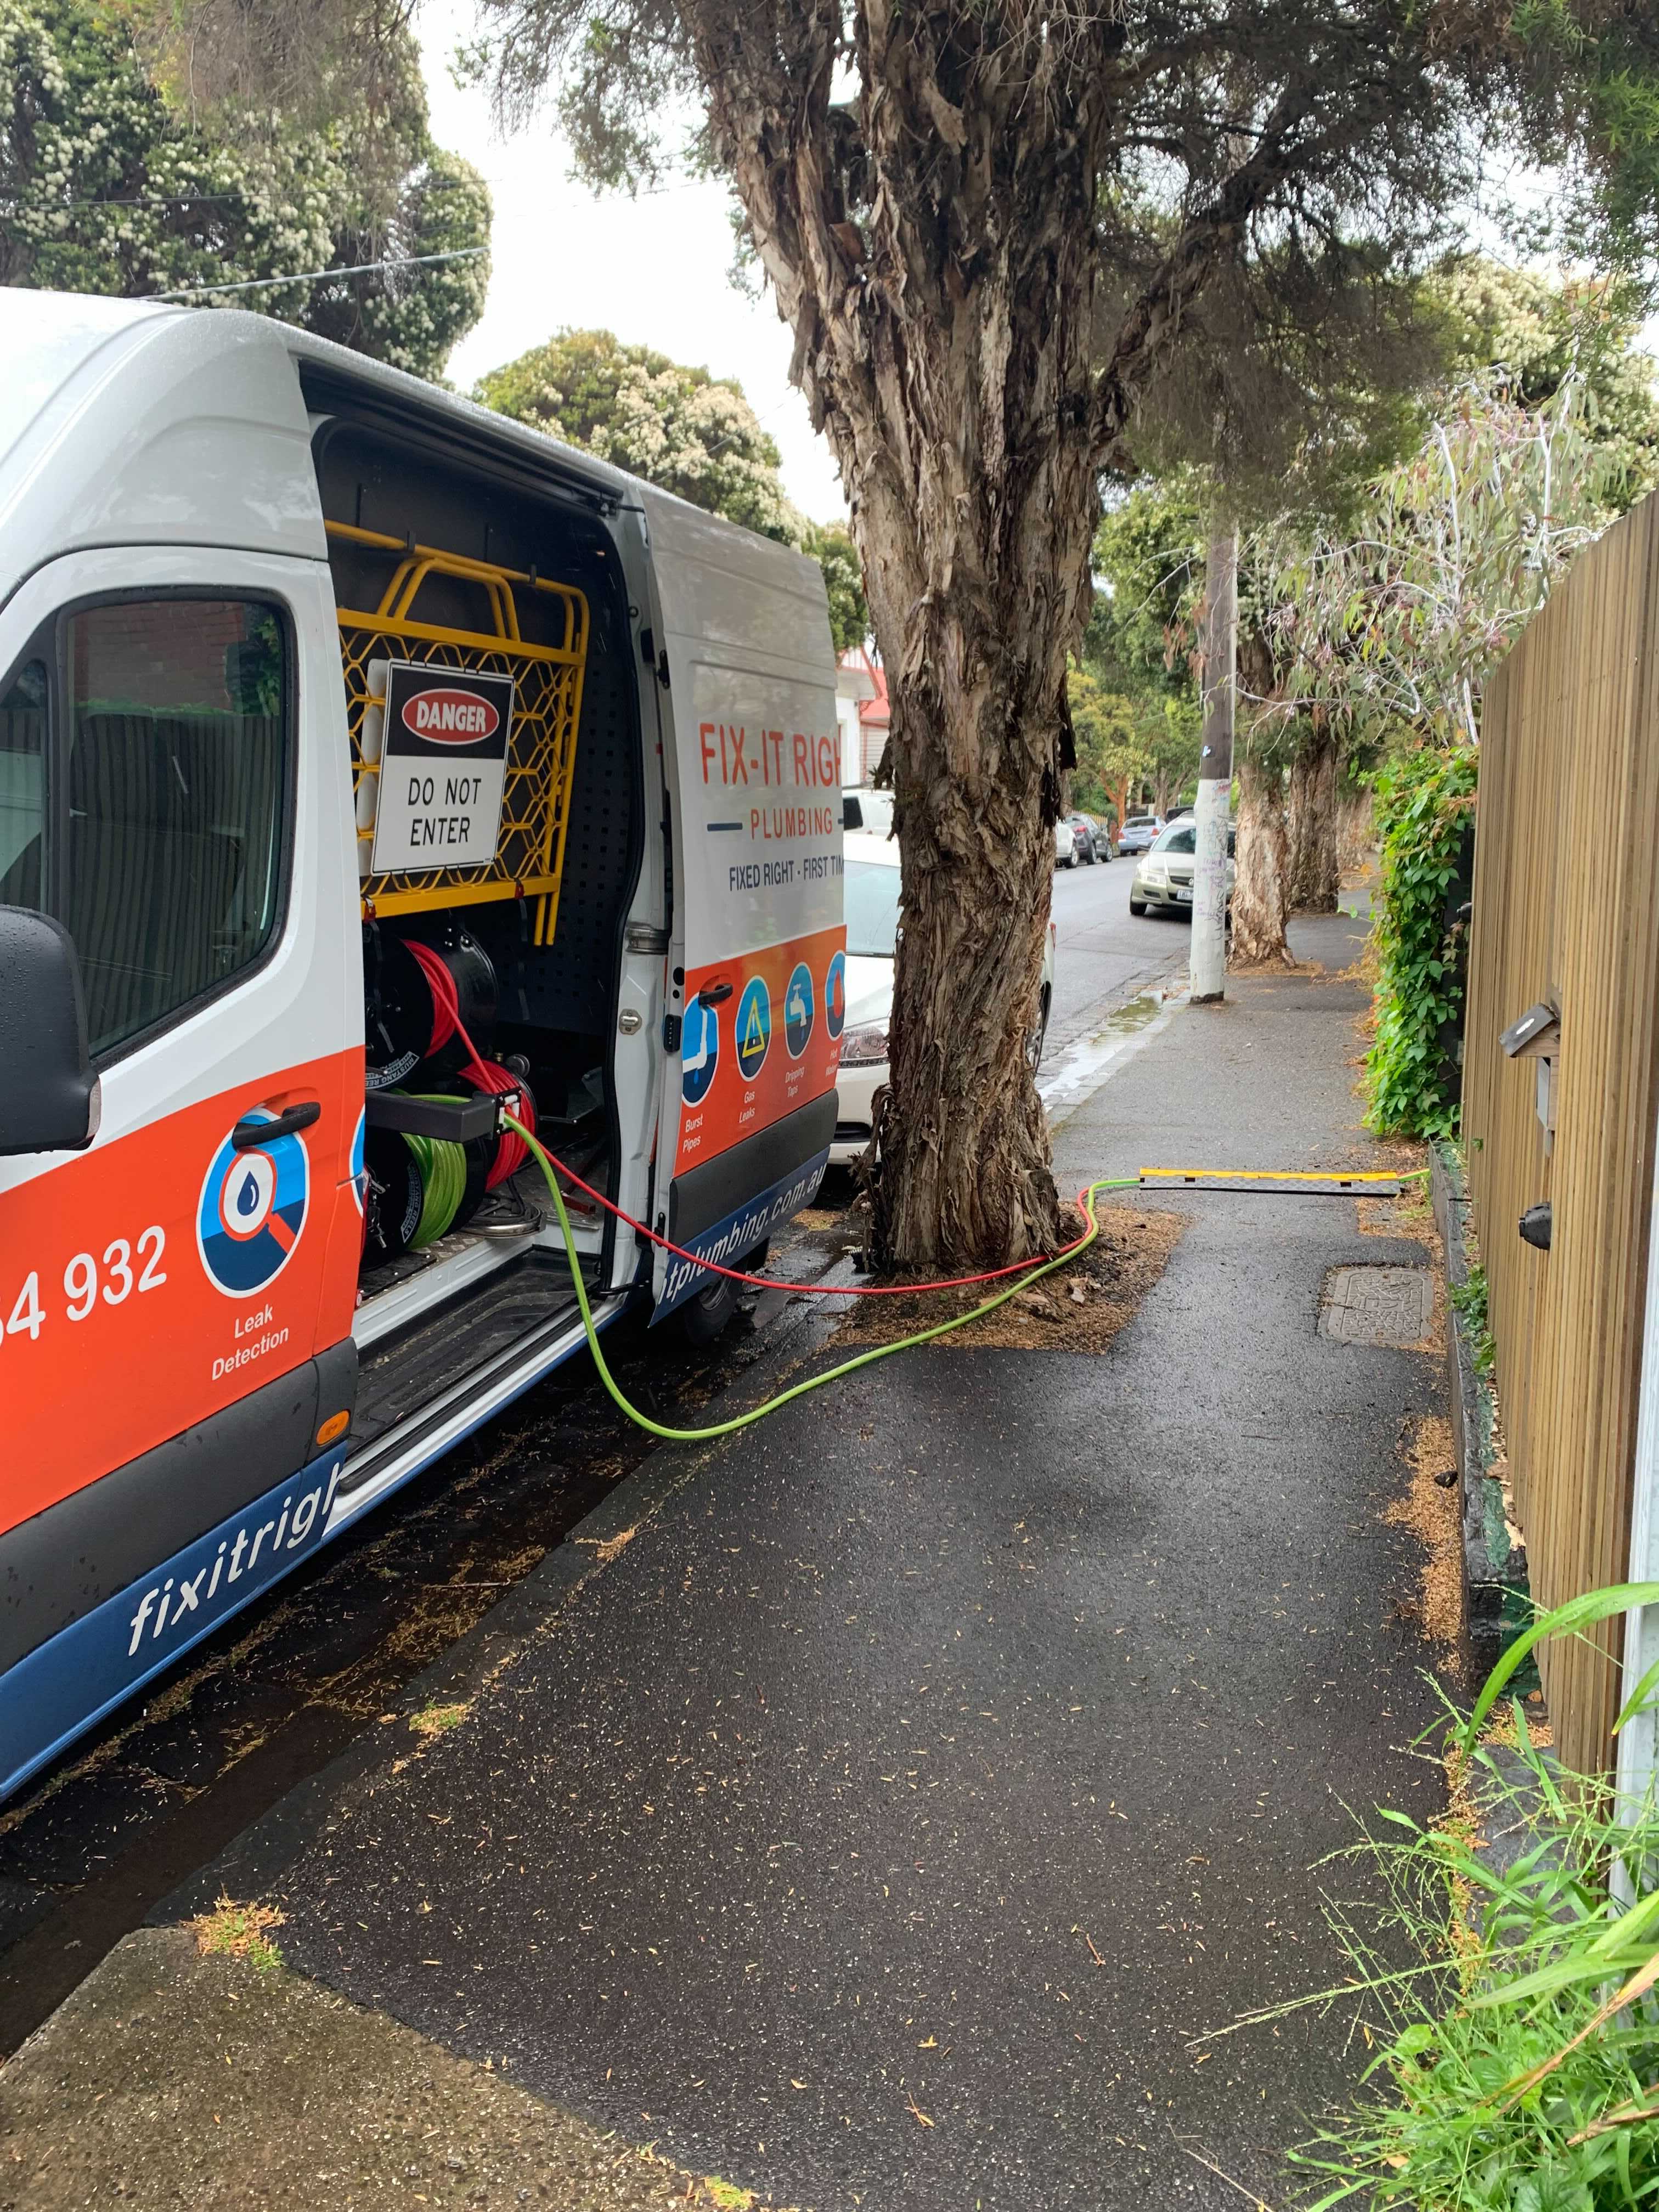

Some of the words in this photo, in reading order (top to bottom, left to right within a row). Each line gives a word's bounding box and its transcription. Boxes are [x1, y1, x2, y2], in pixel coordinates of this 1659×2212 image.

[416, 700, 486, 733] DANGER
[408, 778, 434, 806] DO
[445, 778, 482, 805] NOT
[410, 817, 471, 847] ENTER
[750, 807, 833, 840] PLUMBING
[729, 864, 760, 891] FIXED
[763, 860, 794, 886] RIGHT
[803, 856, 828, 881] FIRST
[830, 1047, 838, 1061] Hot
[382, 1057, 415, 1083] MUSTANG
[785, 1066, 805, 1084] Dripping
[744, 1090, 755, 1104] Gas
[787, 1085, 798, 1098] Taps
[685, 1113, 703, 1133] Burst
[738, 1107, 755, 1124] Leaks
[682, 1135, 701, 1154] Pipes
[404, 1210, 418, 1235] REELS
[0, 1271, 46, 1349] 4
[63, 1225, 167, 1322] 932
[233, 1304, 274, 1339] Leak
[211, 1327, 290, 1381] Detection
